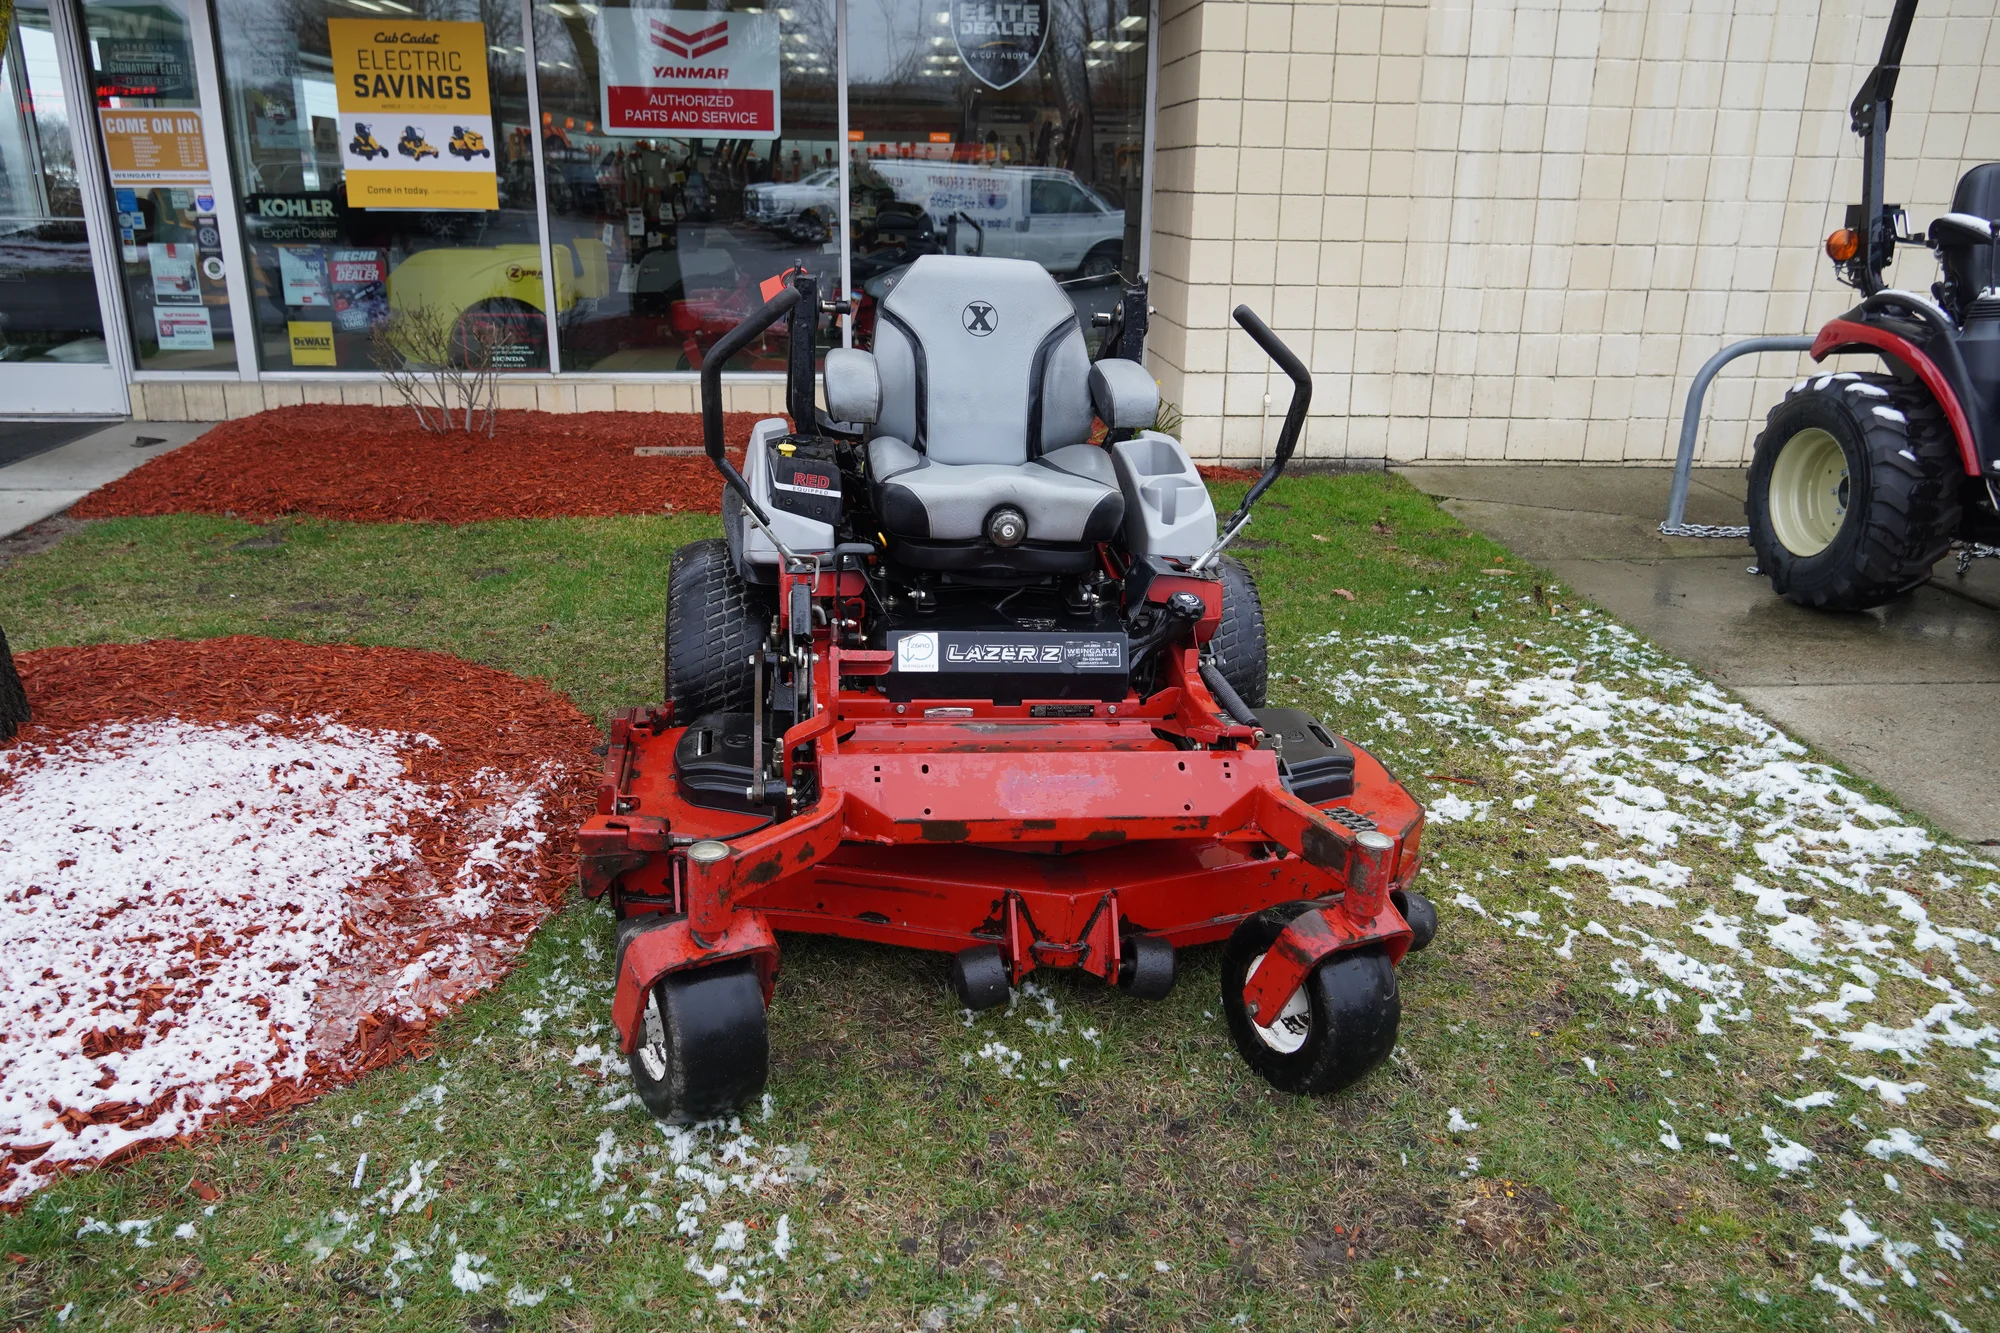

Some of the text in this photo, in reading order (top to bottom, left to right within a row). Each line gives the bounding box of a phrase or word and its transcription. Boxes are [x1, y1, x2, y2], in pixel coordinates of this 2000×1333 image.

[961, 3, 1040, 23] ELITE
[961, 22, 1040, 36] DEALER
[374, 32, 440, 45] Cub Cadet
[113, 43, 173, 51] AUTHORIZED
[357, 49, 462, 72] ELECTRIC
[1001, 52, 1029, 60] ABOVE
[109, 61, 183, 76] SIGNATURE ELITE
[652, 67, 729, 80] YANMAR
[125, 77, 171, 86] DEALER
[353, 74, 471, 99] SAVINGS
[650, 94, 734, 108] AUTHORIZED
[625, 110, 758, 124] PARTS AND SERVICE
[105, 117, 200, 134] COME ON IN!
[367, 186, 392, 195] Come
[394, 185, 402, 194] in
[404, 186, 430, 196] today.
[262, 226, 338, 240] Expert Dealer
[343, 251, 377, 261] ECHO
[308, 260, 320, 269] NO
[335, 263, 377, 271] AUTHORIZED
[336, 270, 379, 281] DEALER
[510, 268, 520, 278] Z
[968, 305, 993, 331] X
[161, 324, 172, 333] 10
[793, 472, 830, 489] RED
[792, 486, 829, 496] EQUIPPED
[946, 644, 1063, 664] LAZER Z
